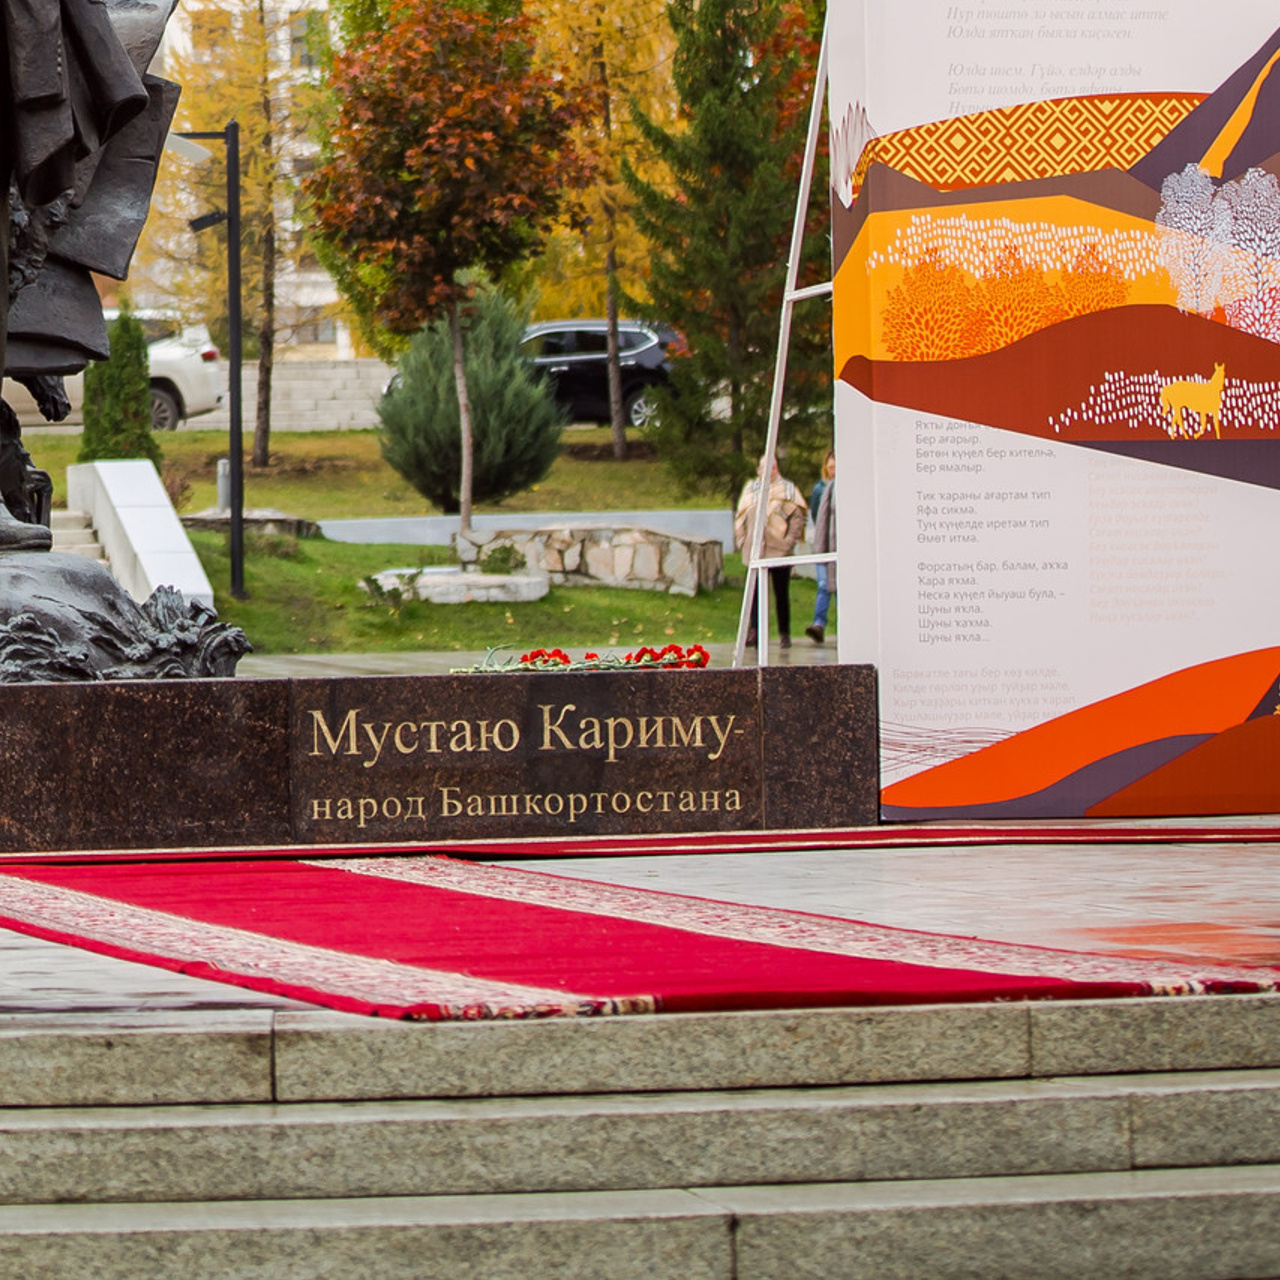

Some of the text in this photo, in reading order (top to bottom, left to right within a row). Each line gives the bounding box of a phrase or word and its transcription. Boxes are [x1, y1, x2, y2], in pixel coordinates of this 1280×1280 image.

[308, 708, 520, 768] Мустаю
[312, 786, 742, 828] народ Башкортостана
